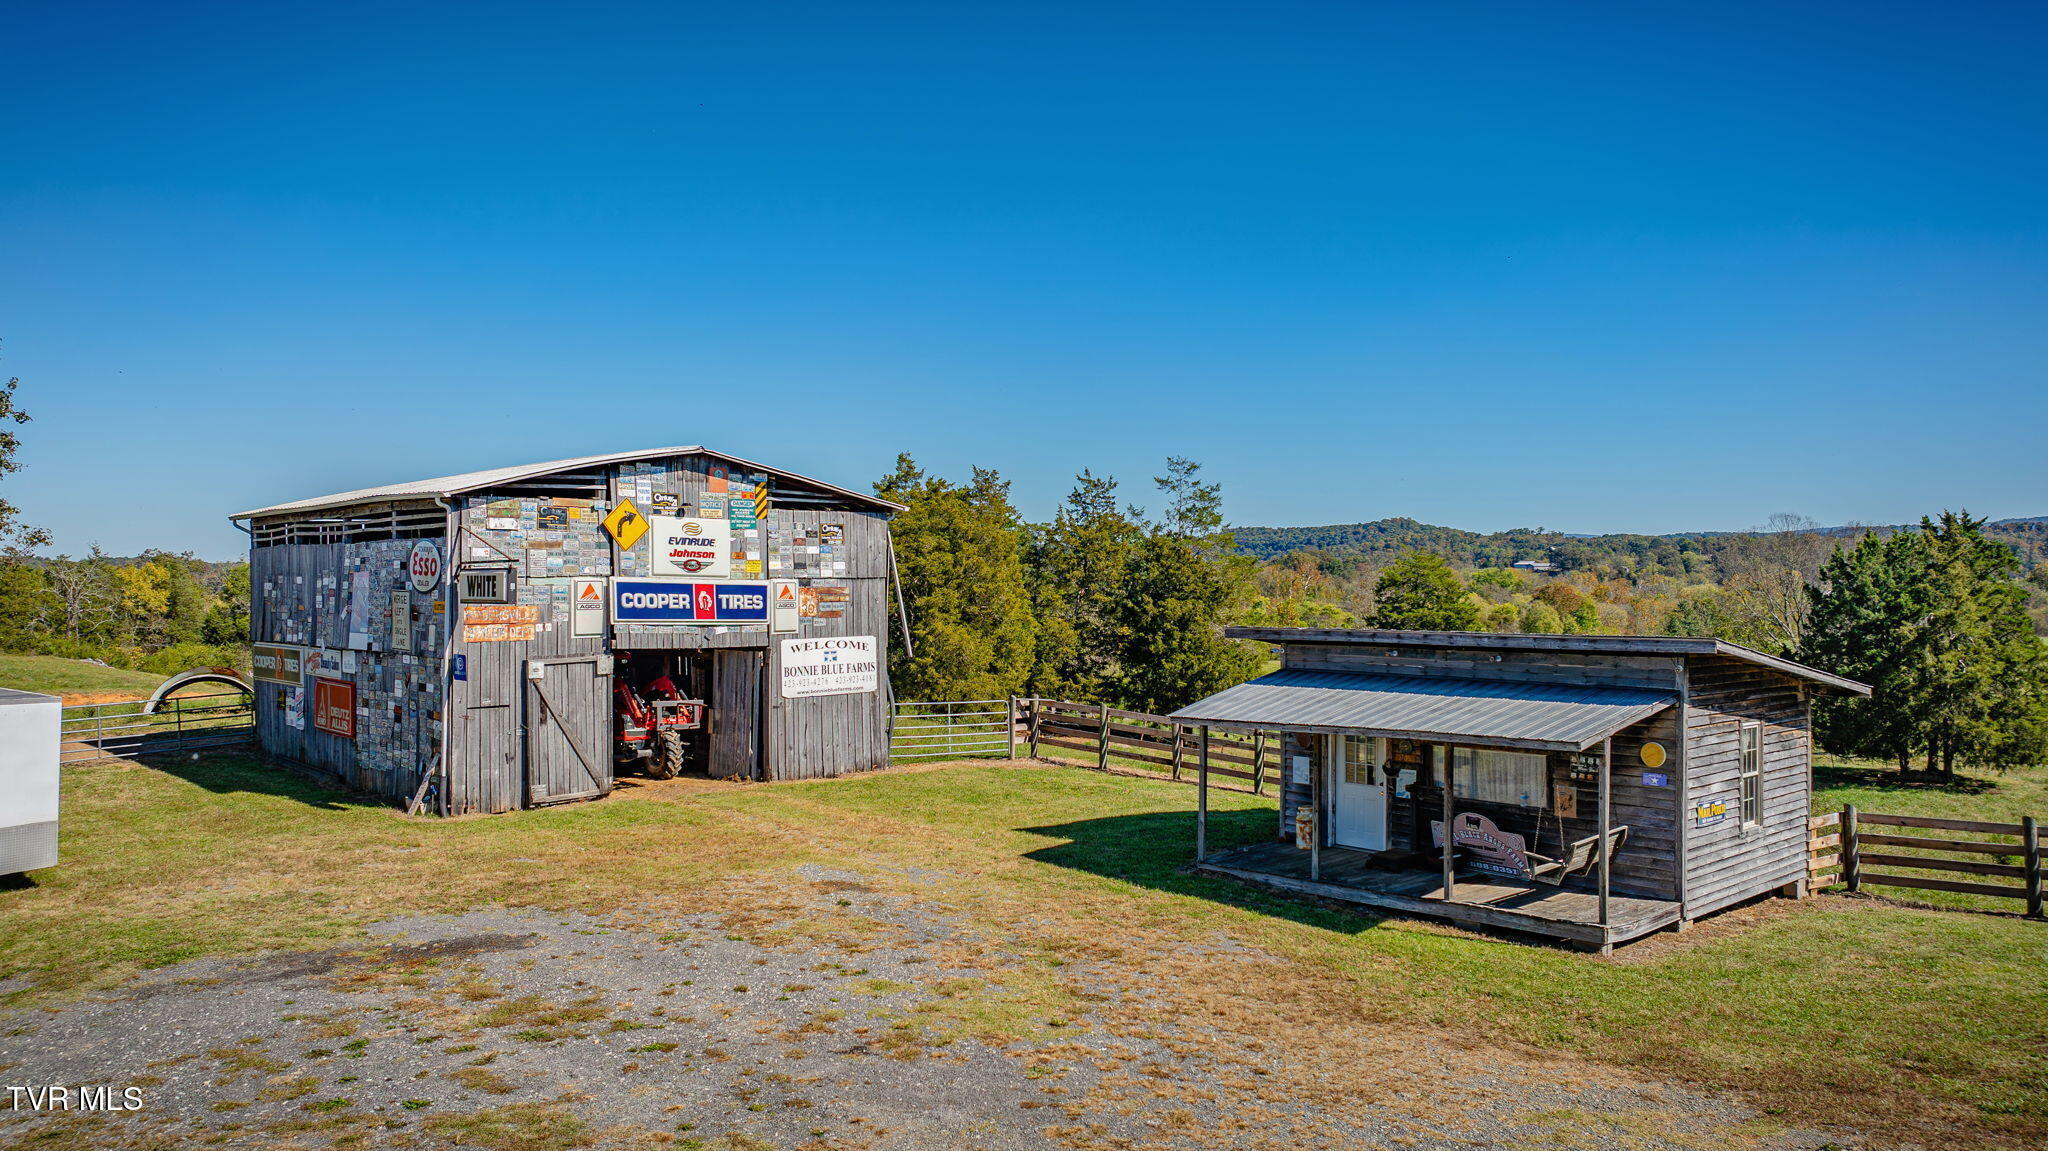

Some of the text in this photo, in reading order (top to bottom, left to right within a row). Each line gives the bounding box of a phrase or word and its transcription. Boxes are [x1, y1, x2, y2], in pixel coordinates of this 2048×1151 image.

[668, 536, 716, 547] EVINRUDE
[669, 548, 715, 559] Johnson
[467, 575, 497, 597] WHITE
[620, 592, 764, 611] COOPER TIRES
[790, 639, 869, 653] WELCOME
[254, 655, 276, 670] COOPER
[784, 661, 876, 678] BONNIE BLUE FARMS
[330, 706, 350, 720] DEUTZ
[331, 717, 349, 732] ALLIS
[1461, 830, 1481, 840] BLACK
[1483, 832, 1506, 851] ANGUS
[1506, 847, 1525, 869] FARM
